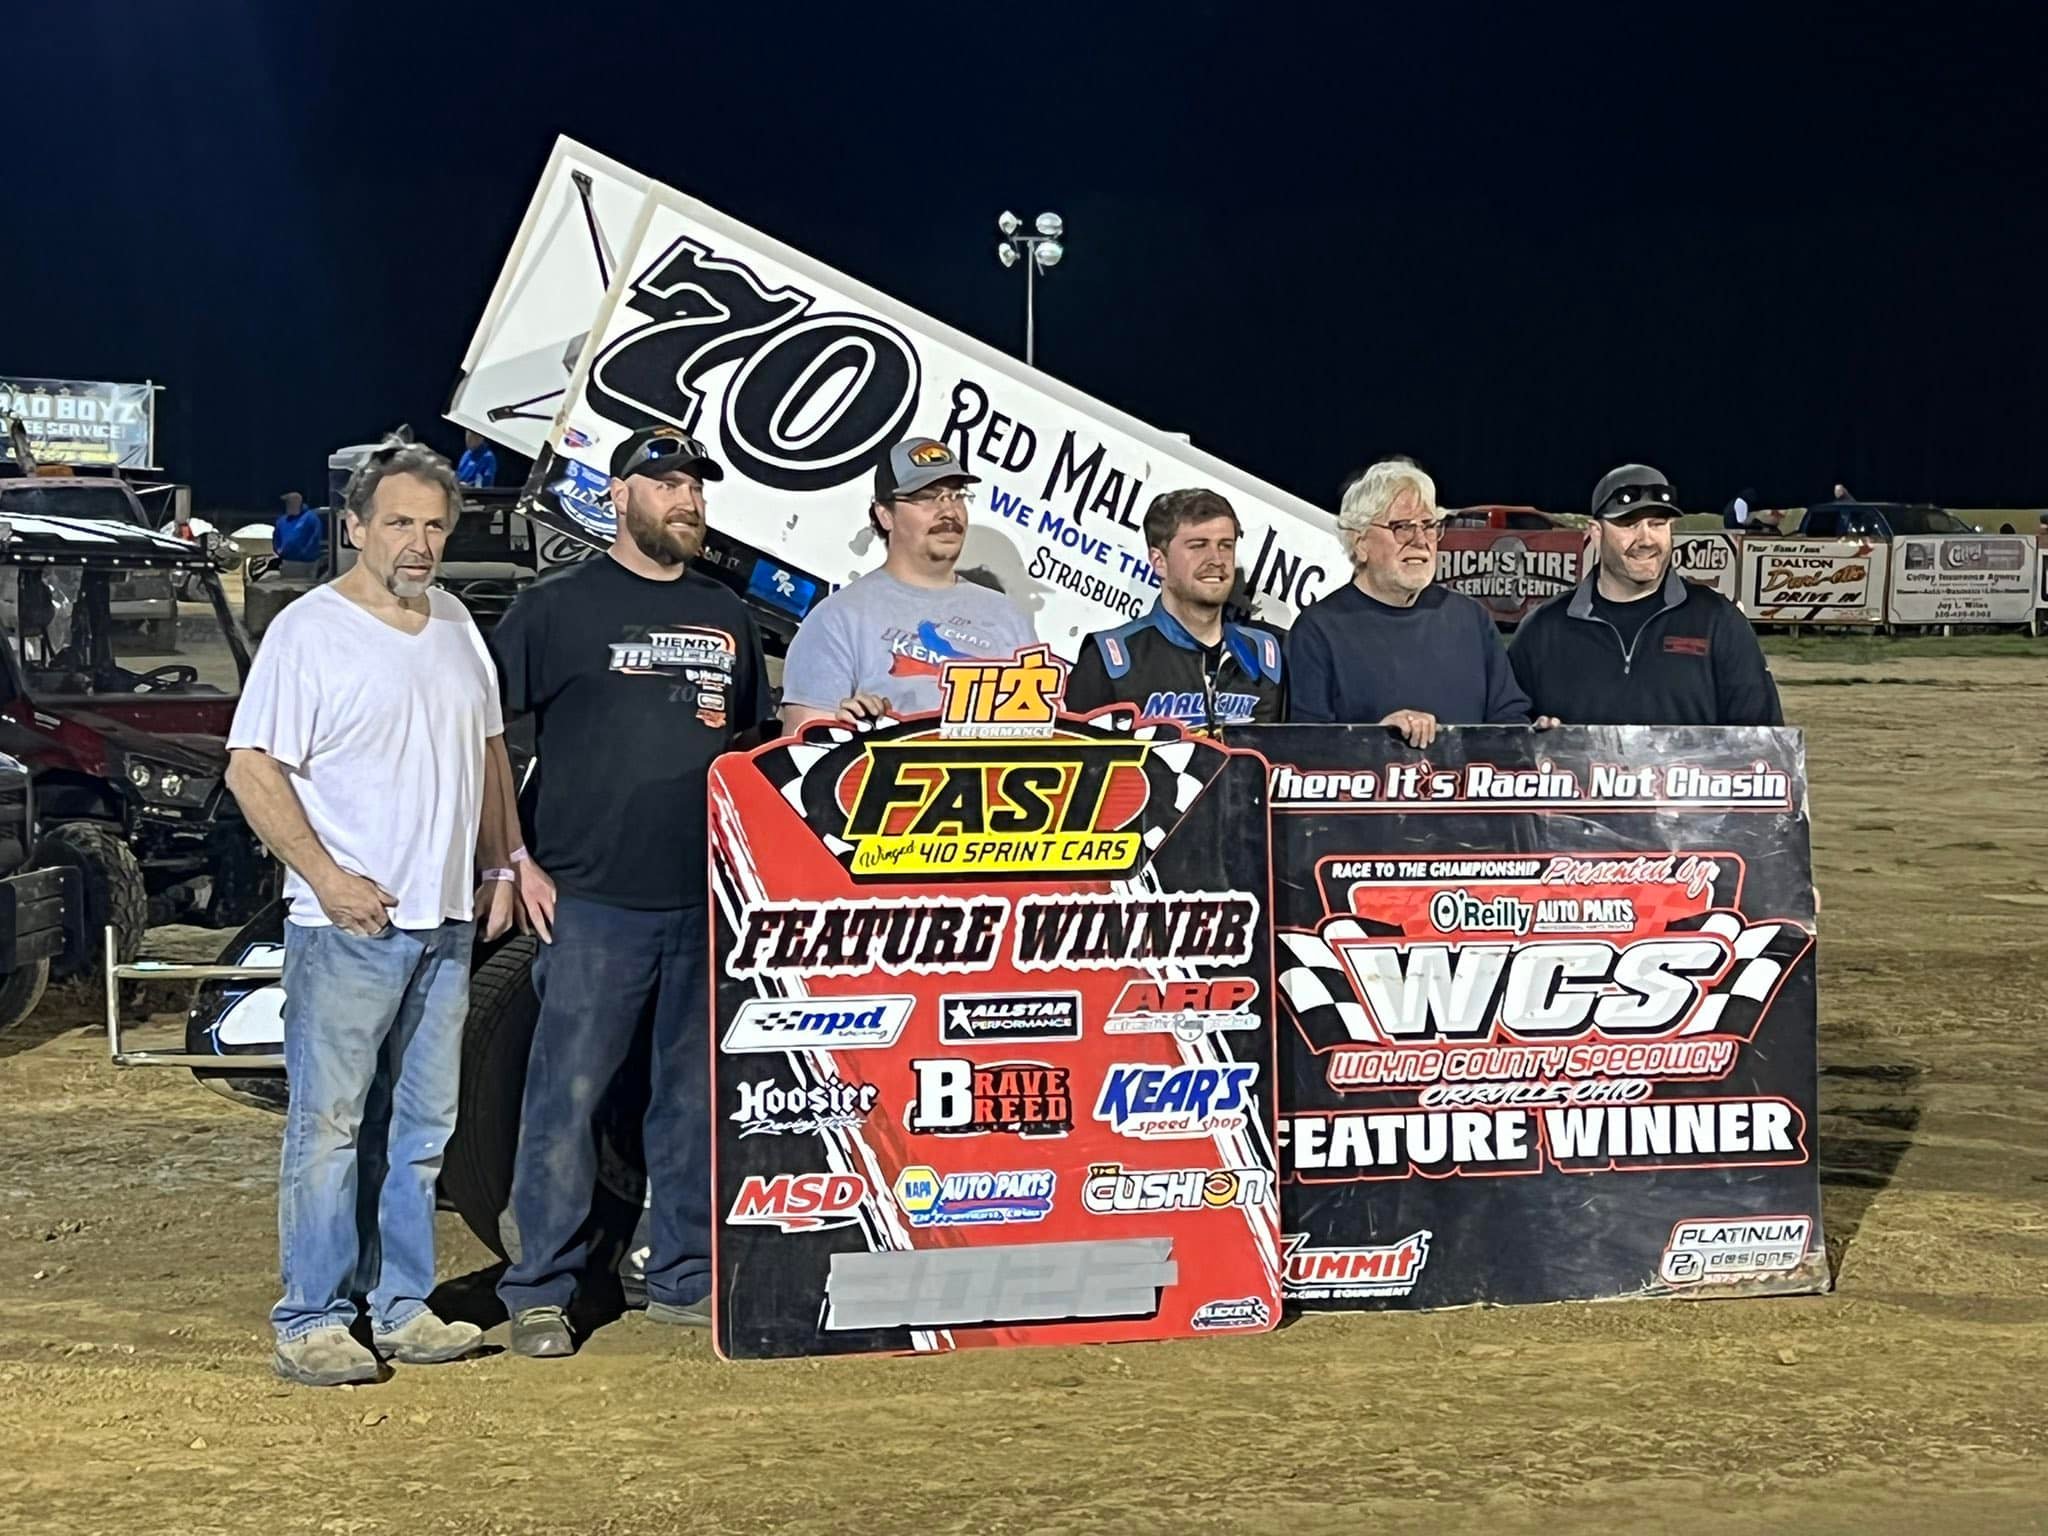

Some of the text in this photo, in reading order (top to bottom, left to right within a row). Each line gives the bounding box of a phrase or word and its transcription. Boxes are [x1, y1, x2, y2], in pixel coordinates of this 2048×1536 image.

[587, 233, 922, 490] 70
[56, 398, 139, 423] BOYZ
[47, 422, 121, 439] SERVICE
[990, 485, 1034, 527] WE
[1037, 510, 1112, 564] MOVE
[1435, 550, 1577, 583] RICH'S TIRE
[1686, 540, 1729, 570] Sales
[1771, 558, 1834, 569] DALTON
[1028, 545, 1144, 620] STRASBURG
[1457, 578, 1512, 596] SERVICE
[1773, 591, 1834, 603] DRIVE
[656, 636, 722, 650] HENRY
[847, 743, 1149, 837] FAST
[1387, 759, 1455, 798] It's
[1591, 766, 1657, 797] Not
[1666, 762, 1786, 797] Chasin
[919, 842, 956, 863] 410
[963, 841, 1056, 862] SPRINT
[1061, 839, 1129, 860] CARS
[1332, 862, 1371, 878] RACE
[1375, 862, 1395, 878] TO
[1399, 862, 1427, 878] THE
[1430, 861, 1540, 878] CHAMPIONSHIP
[1540, 856, 1677, 884] Presented
[1433, 890, 1530, 931] O'Reilly
[1536, 900, 1579, 923] AUTO
[730, 896, 1259, 975] FEATURE WINNER
[1113, 981, 1257, 1014] ARP
[1345, 942, 1723, 1036] WCS
[797, 1005, 888, 1036] mpd
[971, 1002, 1073, 1018] ALLSTAR
[971, 1018, 1073, 1030] PERFORMANCE
[1444, 1047, 1567, 1080] COUNTY
[1568, 1041, 1735, 1076] SPEEDWAY
[729, 1075, 880, 1122] Hoosier
[1099, 1067, 1255, 1126] KEAR'S
[1575, 1081, 1650, 1102] OHIO
[1137, 1116, 1243, 1135] speed shop
[1545, 1102, 1794, 1159] WINNER
[735, 1175, 865, 1217] MSD
[905, 1172, 1052, 1200] NAPA AUTO PARTS
[1083, 1168, 1267, 1213] CUSHION
[1680, 1225, 1804, 1245] PLATINUM
[1711, 1251, 1794, 1266] designs
